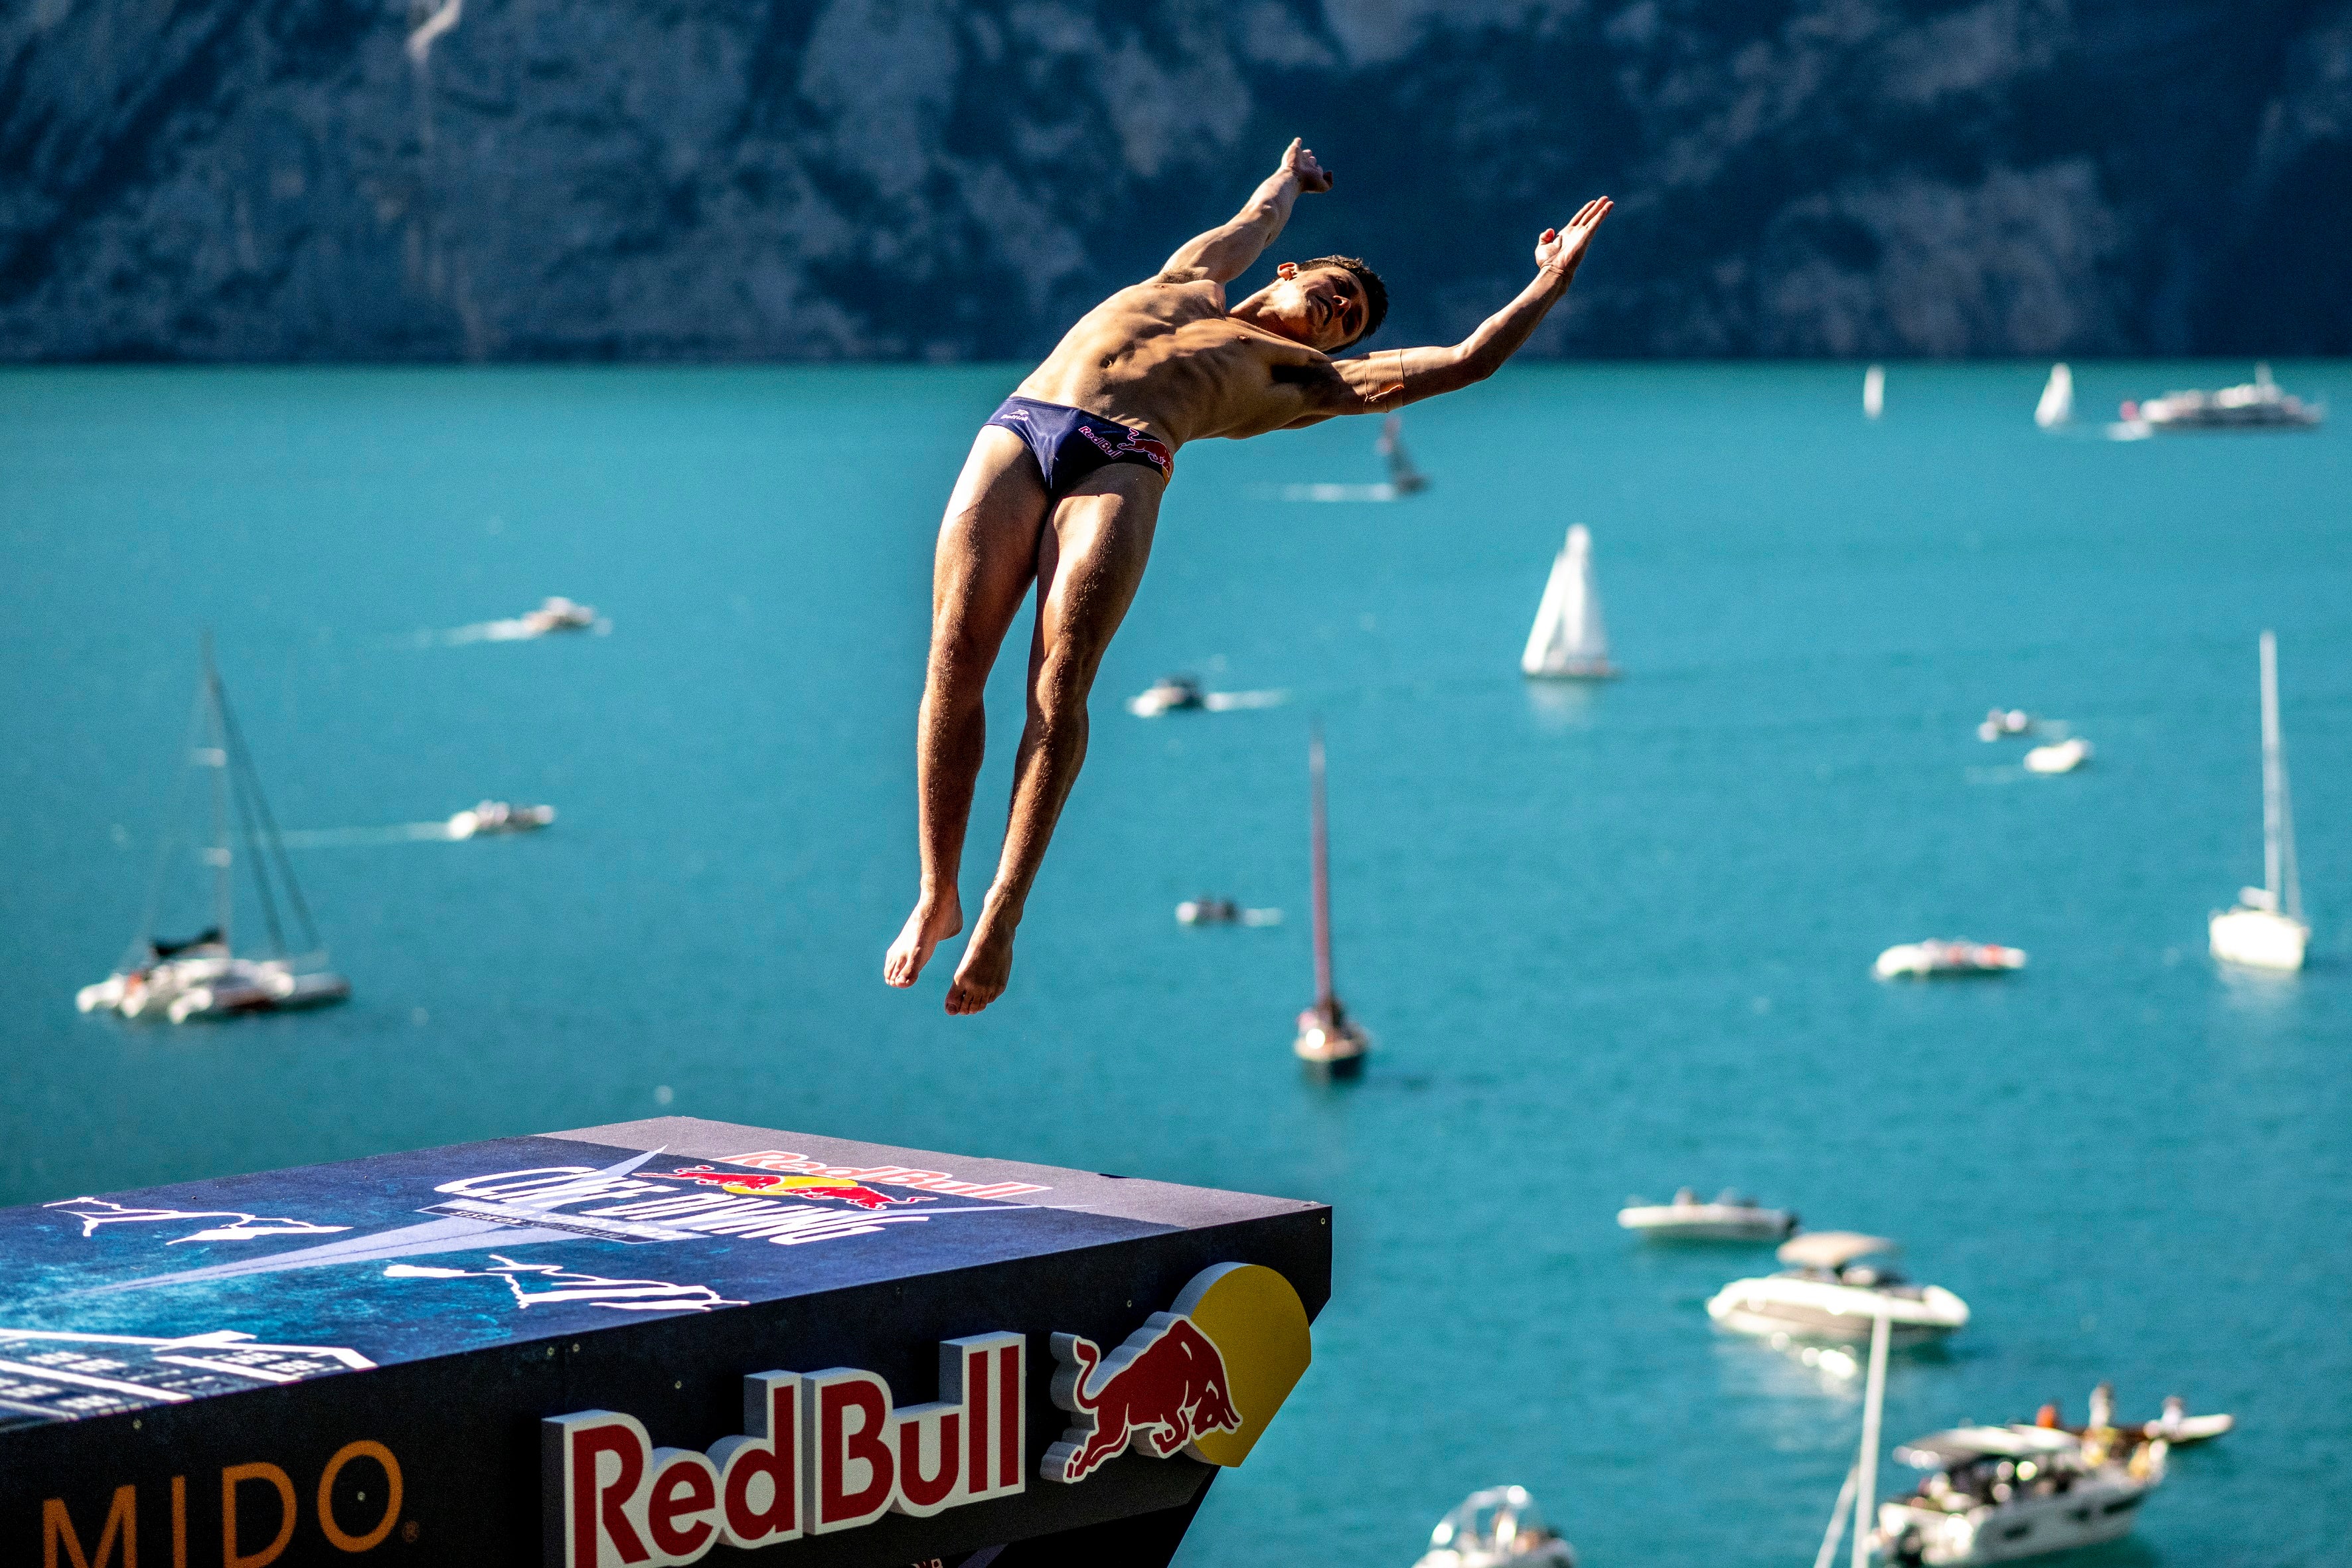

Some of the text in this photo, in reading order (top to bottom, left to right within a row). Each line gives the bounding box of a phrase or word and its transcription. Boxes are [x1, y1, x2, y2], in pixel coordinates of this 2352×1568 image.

[433, 1166, 679, 1207] CLIFF
[449, 1211, 523, 1223] SISIKON
[580, 1193, 929, 1245] DIVING
[42, 1440, 404, 1568] MIDO
